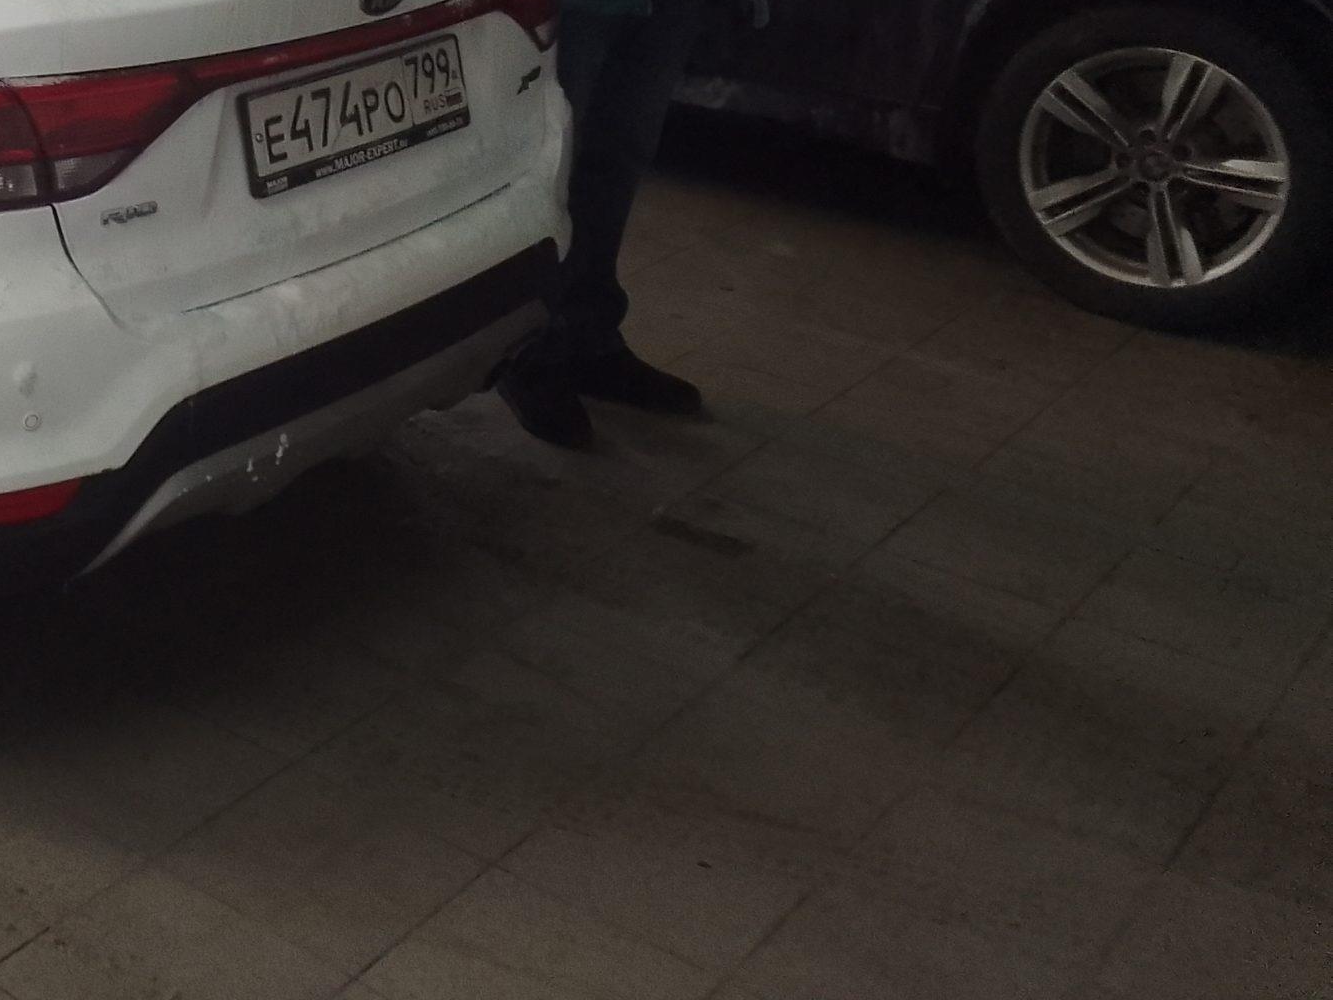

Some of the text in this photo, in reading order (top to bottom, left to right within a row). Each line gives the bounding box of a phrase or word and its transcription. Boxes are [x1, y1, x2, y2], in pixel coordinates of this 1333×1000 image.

[404, 48, 451, 99] 799
[264, 80, 406, 165] E474PO
[424, 94, 447, 115] RUS
